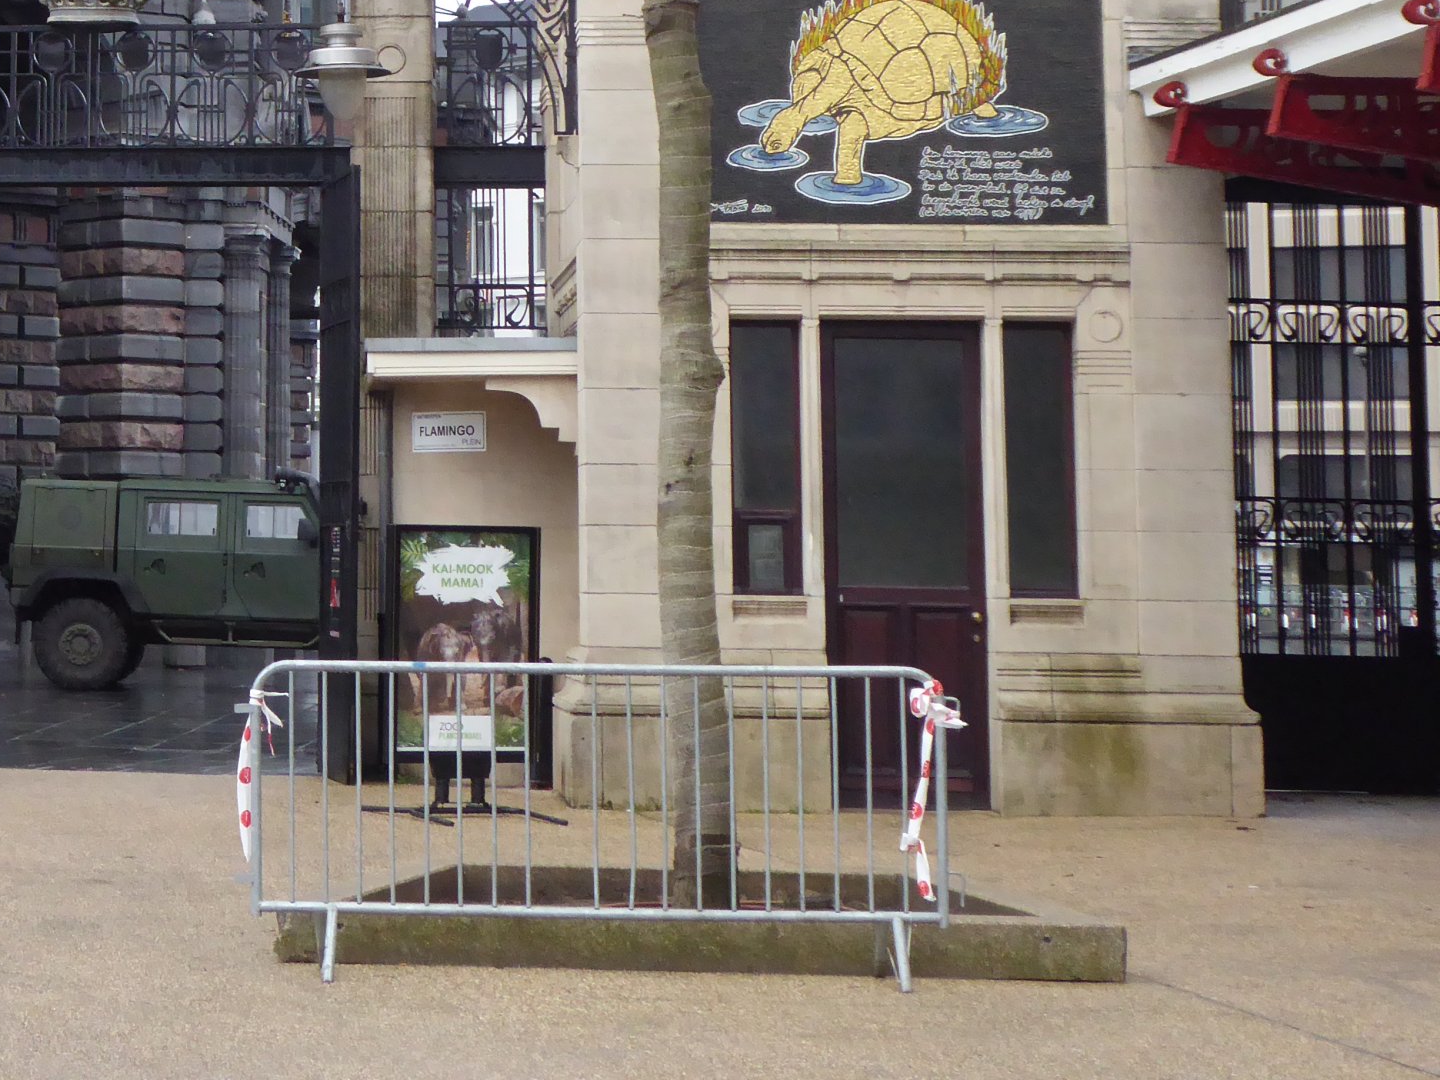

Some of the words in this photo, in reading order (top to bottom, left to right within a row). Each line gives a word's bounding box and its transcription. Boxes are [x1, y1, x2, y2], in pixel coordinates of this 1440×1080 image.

[419, 425, 475, 437] FLAMINGO
[432, 563, 494, 574] KAI-MOOK
[440, 577, 484, 588] MAMA!
